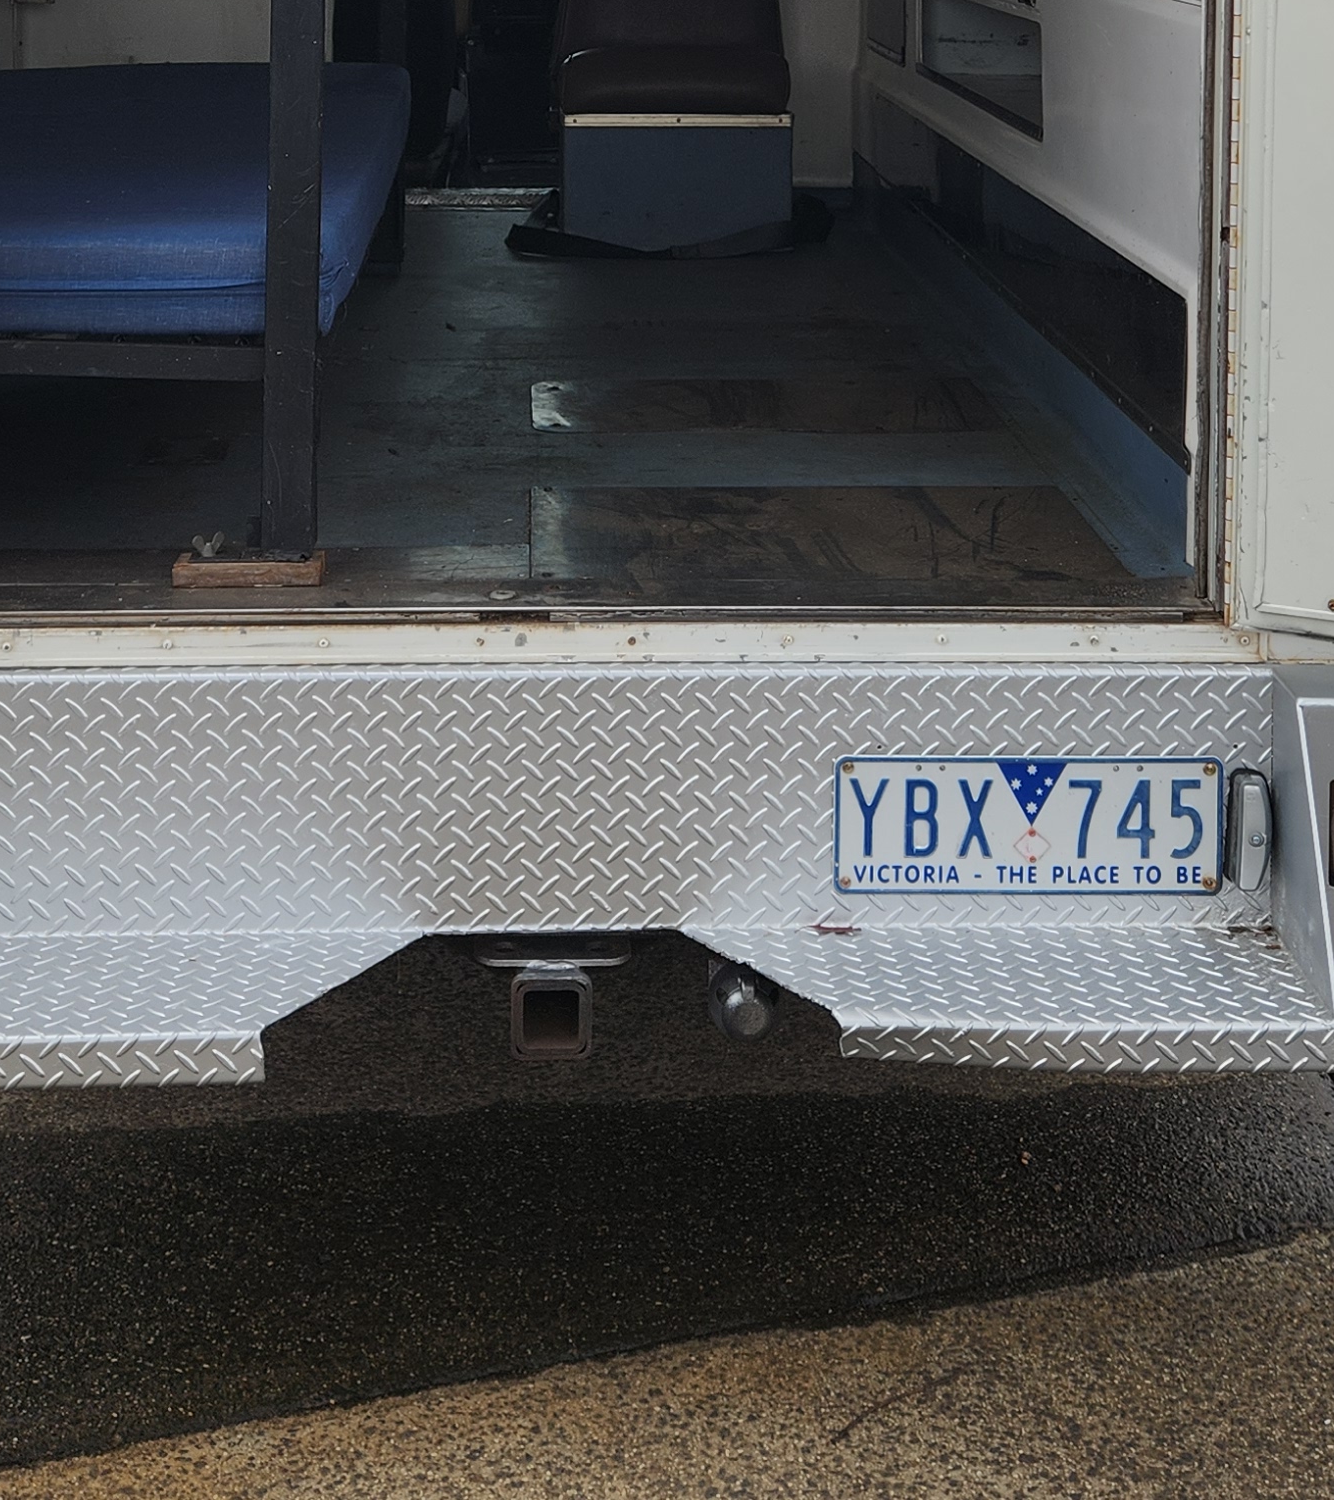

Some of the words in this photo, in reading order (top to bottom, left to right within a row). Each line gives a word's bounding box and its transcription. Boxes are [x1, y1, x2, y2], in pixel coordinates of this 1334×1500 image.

[850, 778, 993, 859] YBX
[1069, 779, 1203, 860] 745
[854, 864, 960, 884] VICTORIA
[996, 865, 1037, 884] THE
[1052, 865, 1120, 884] PLACE
[1133, 865, 1163, 884] TO
[1176, 865, 1203, 884] BE
